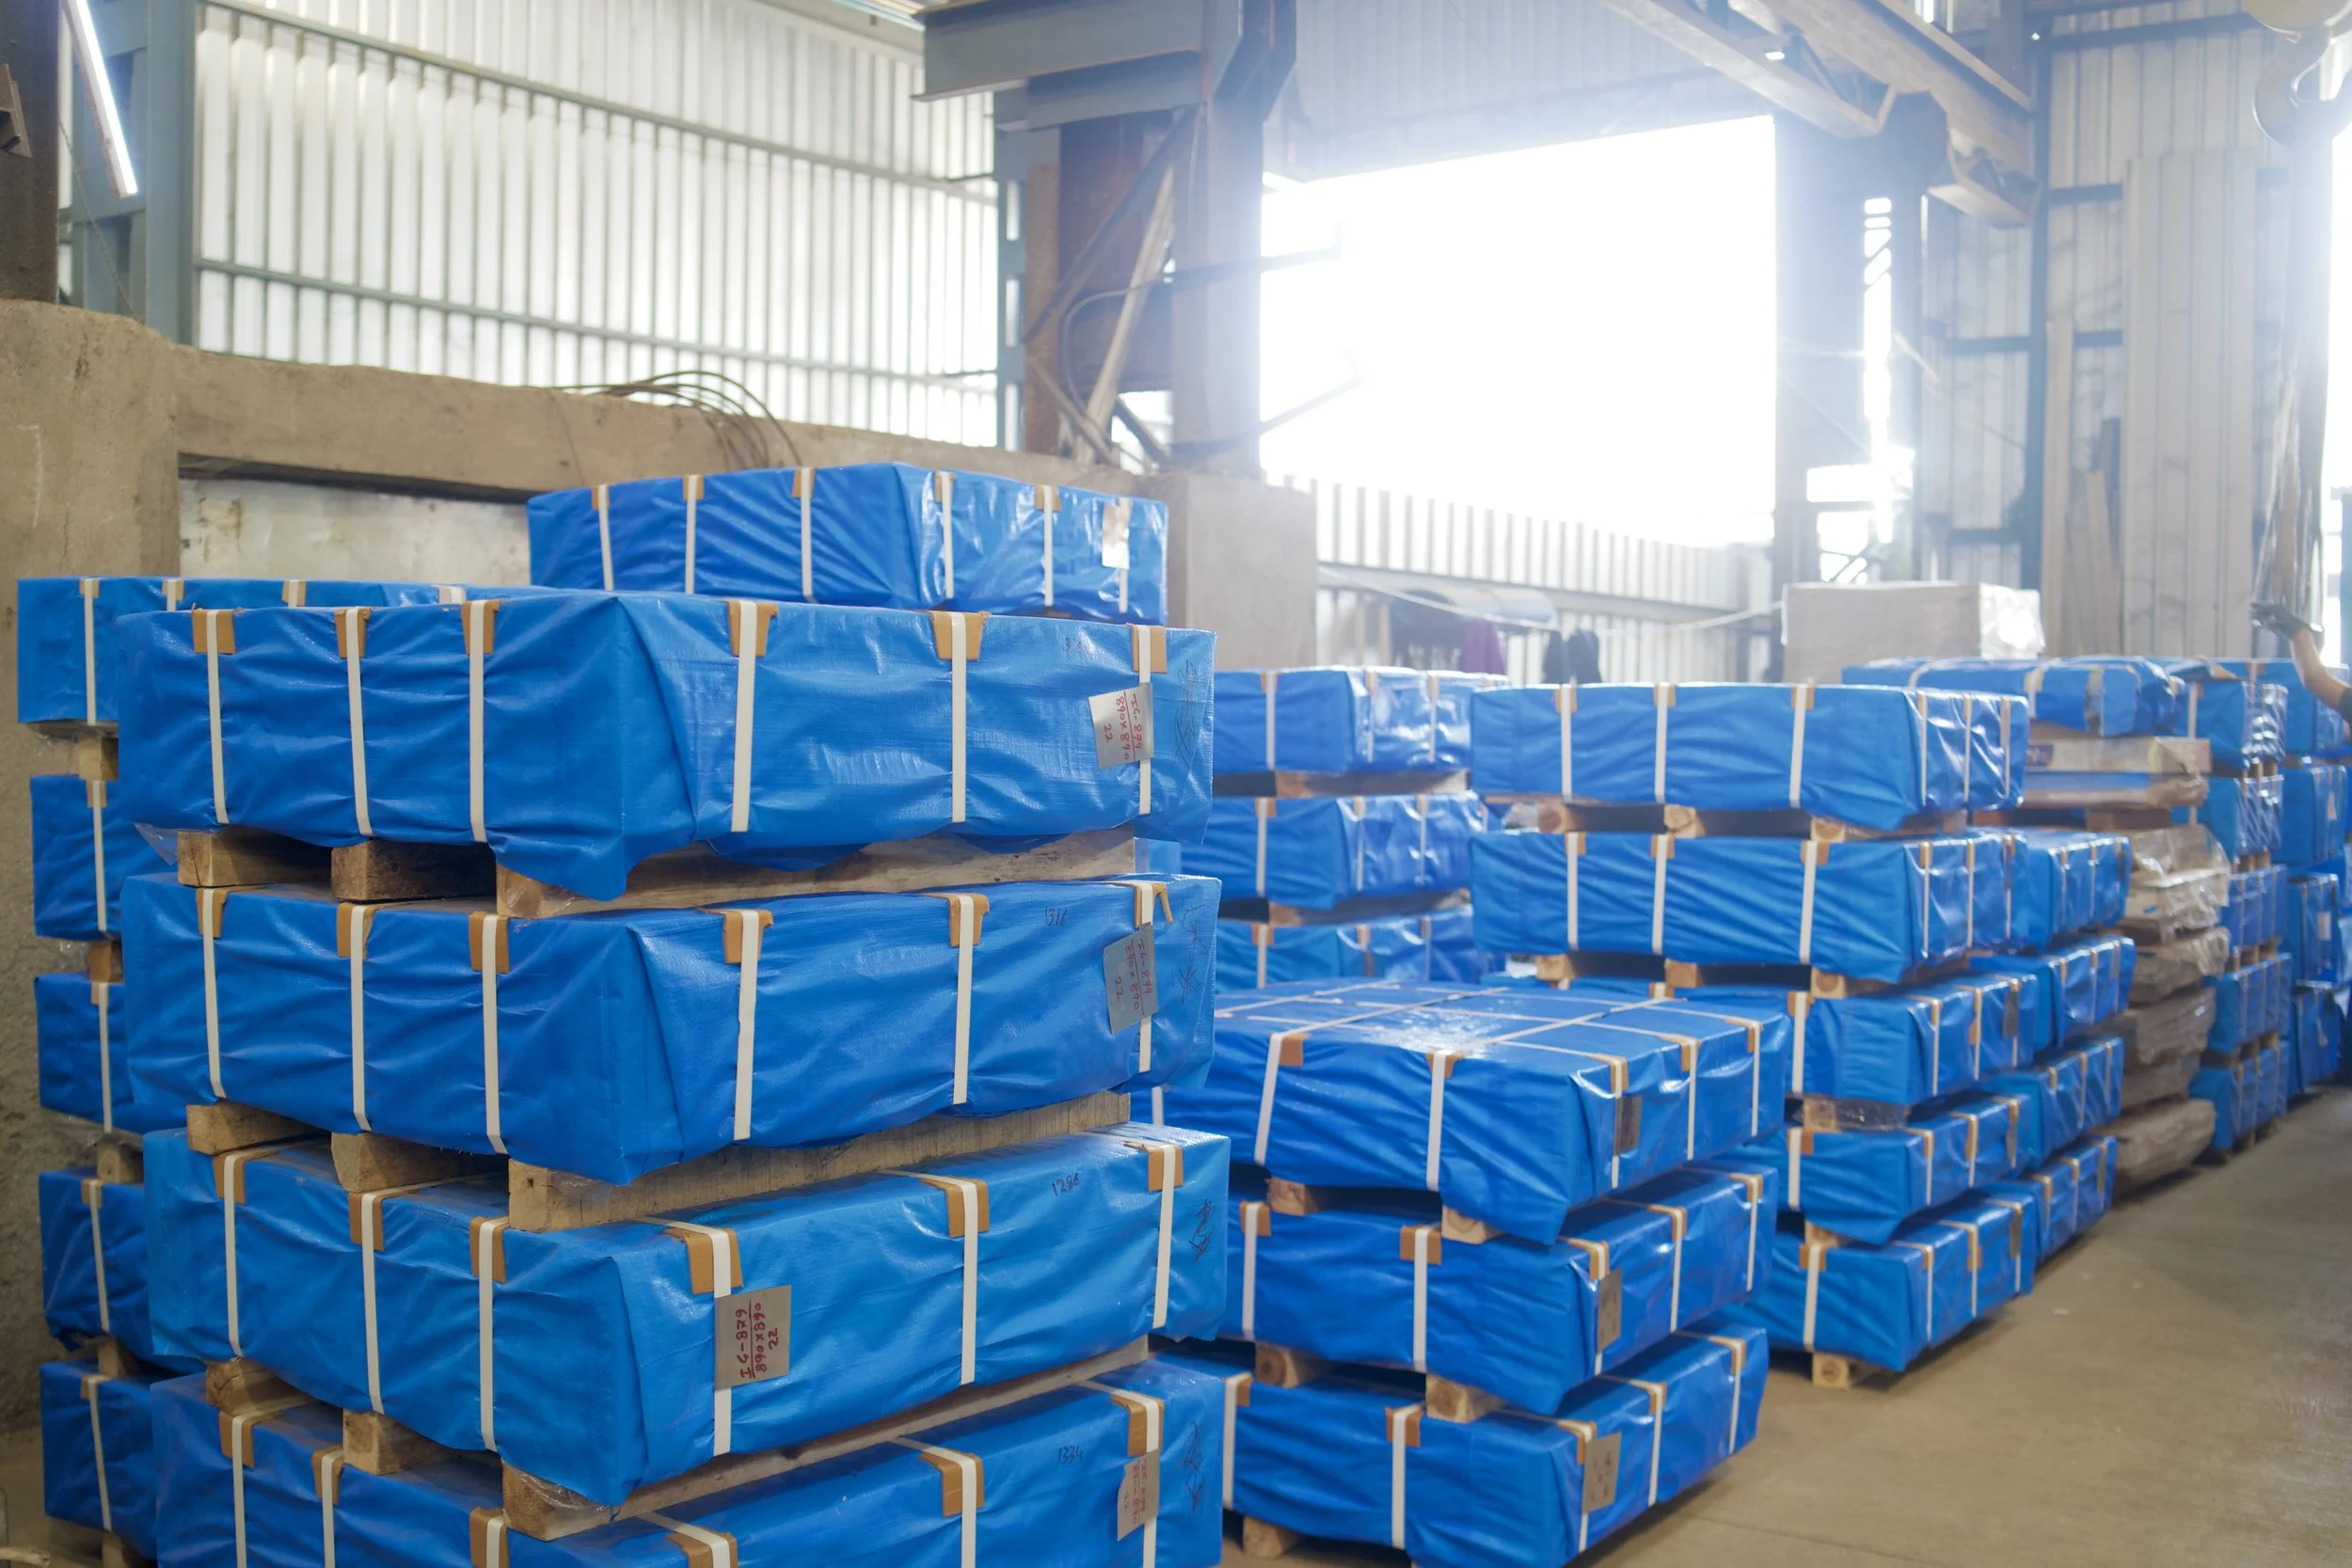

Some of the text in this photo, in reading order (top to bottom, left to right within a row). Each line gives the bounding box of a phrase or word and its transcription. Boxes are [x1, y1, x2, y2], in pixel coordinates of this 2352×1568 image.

[1104, 723, 1114, 743] 22
[1114, 976, 1123, 1003] 22
[1051, 1172, 1079, 1196] 1286
[768, 1327, 779, 1351] 22
